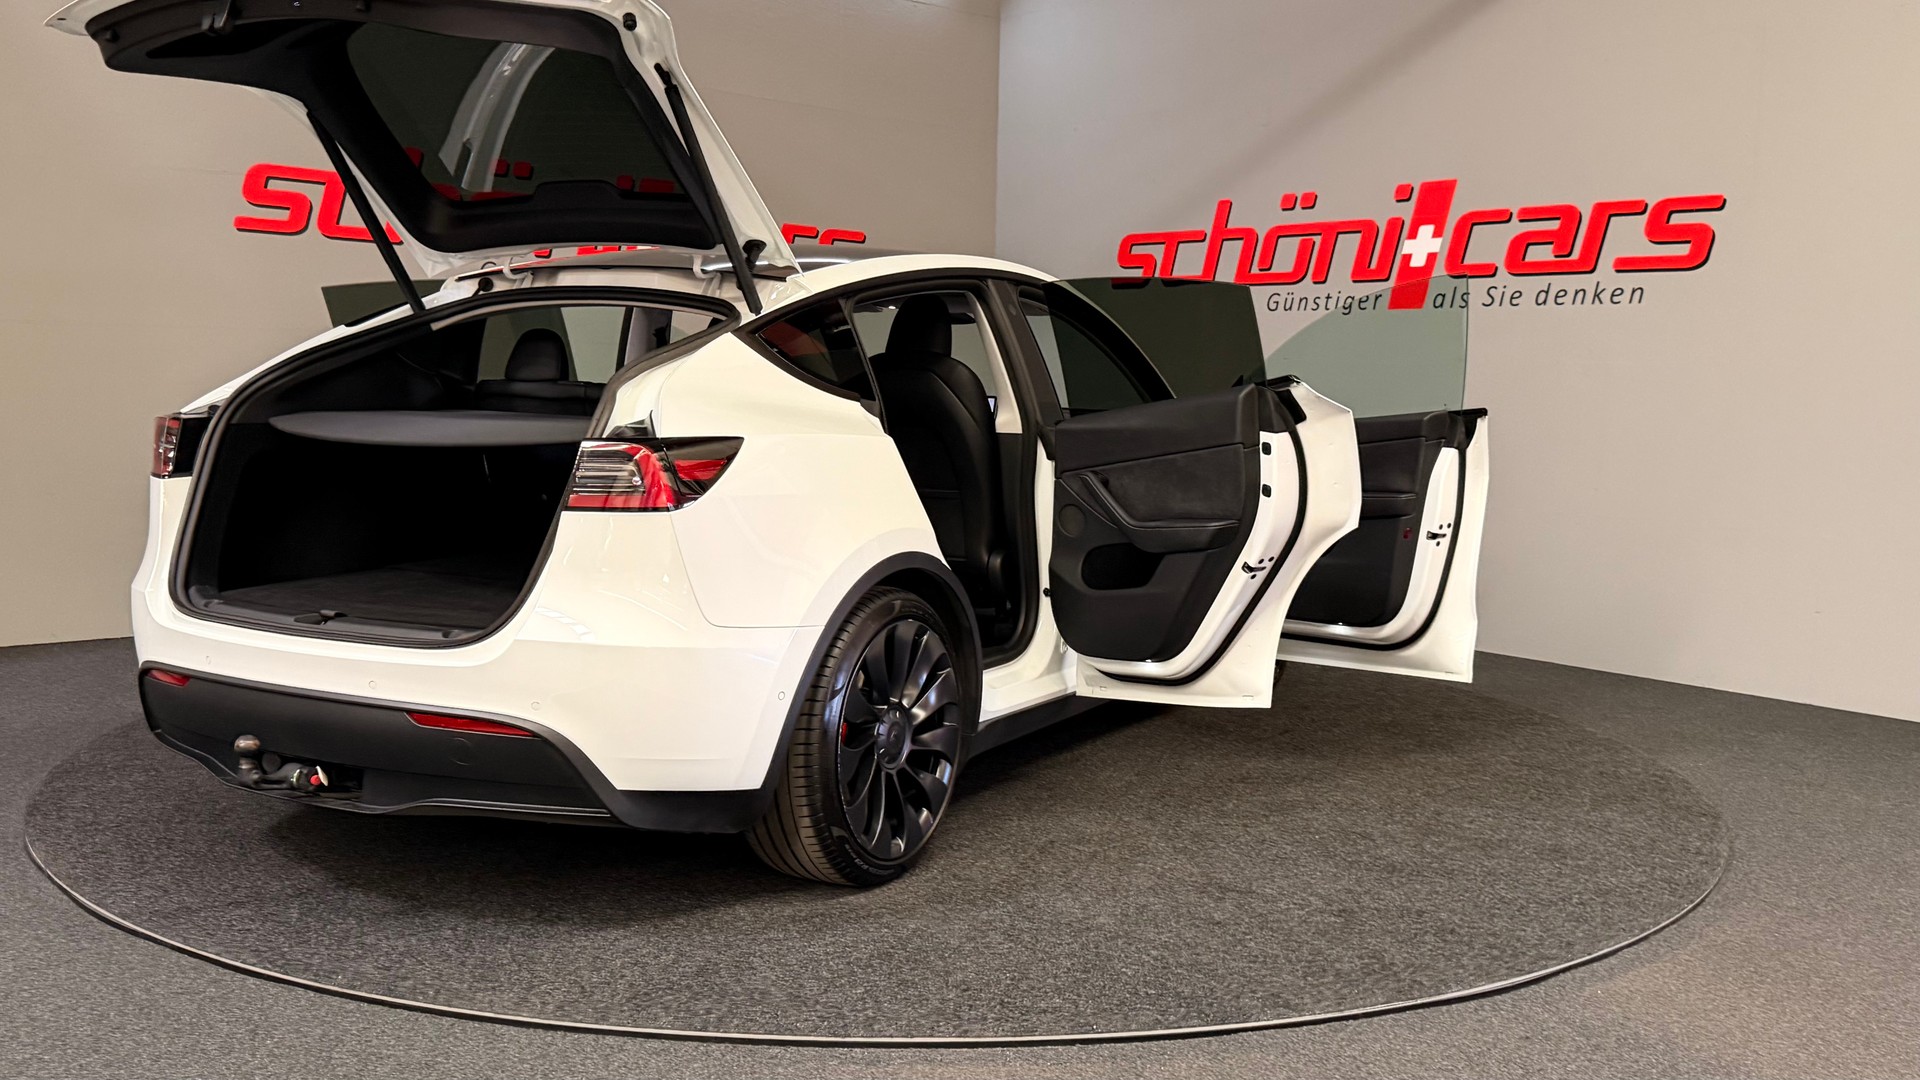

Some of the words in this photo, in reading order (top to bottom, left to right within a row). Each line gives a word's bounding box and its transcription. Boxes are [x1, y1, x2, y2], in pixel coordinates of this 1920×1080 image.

[1266, 291, 1383, 315] Günstiger
[1432, 285, 1471, 309] als
[1481, 285, 1523, 307] Sie
[1534, 281, 1645, 306] denken
